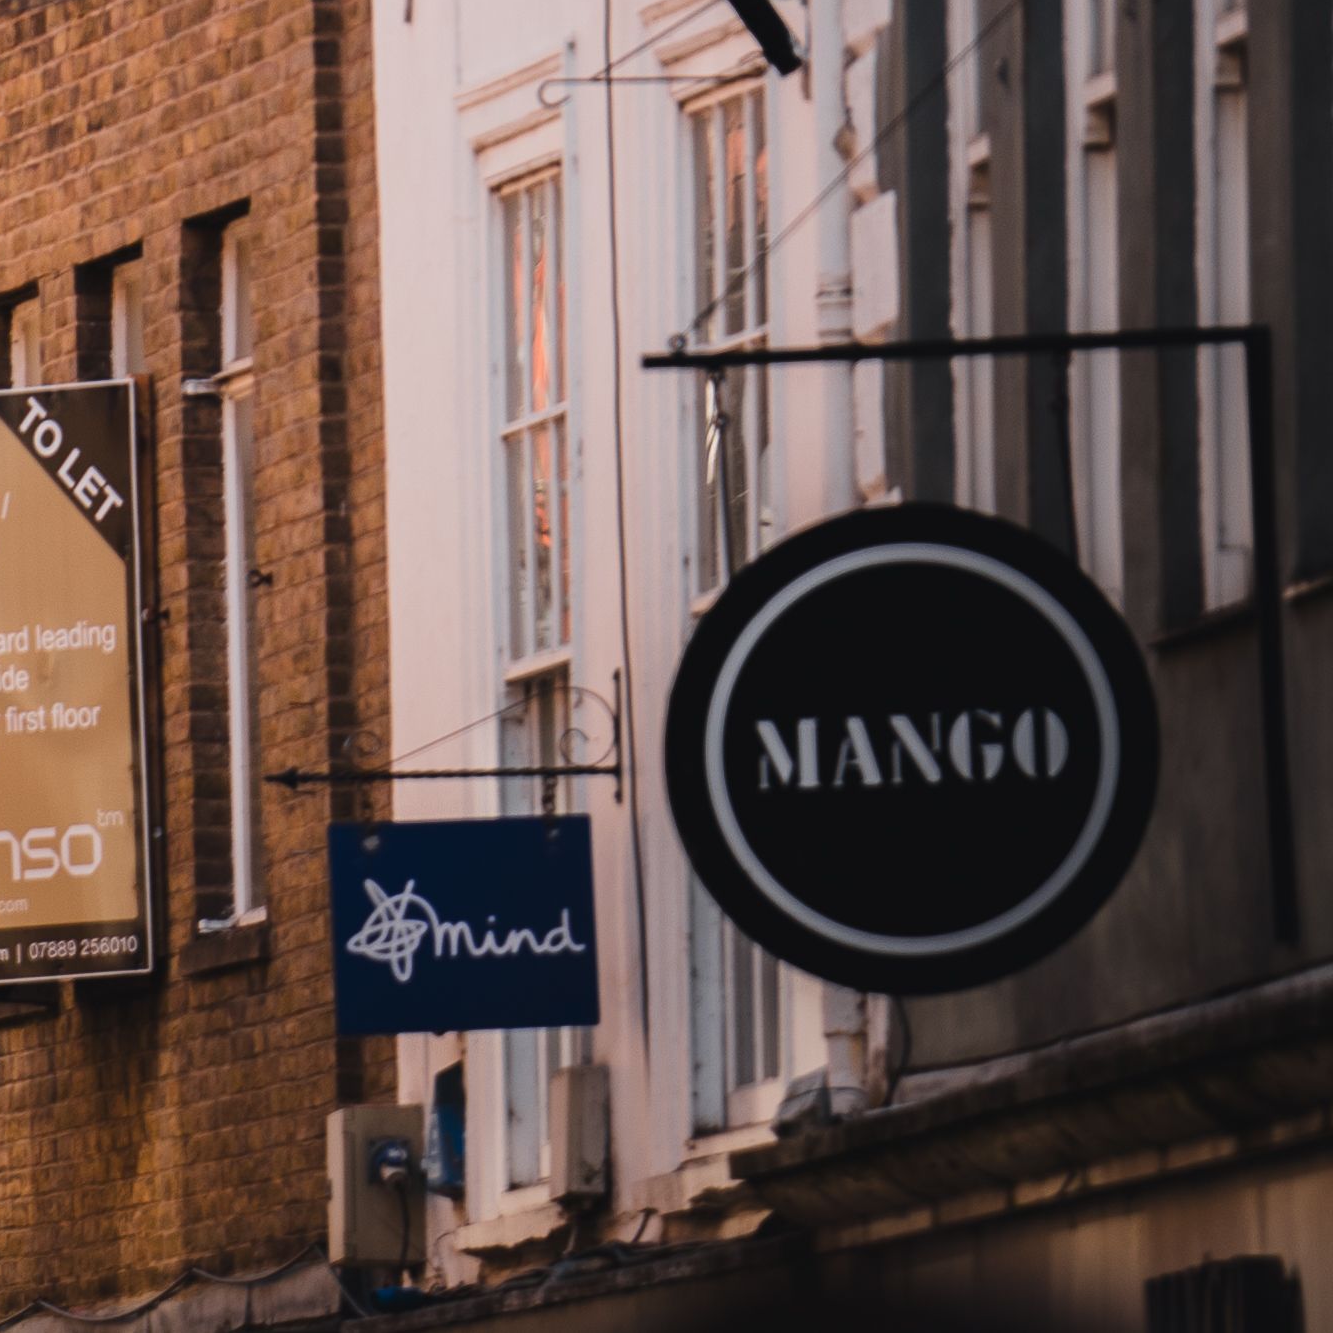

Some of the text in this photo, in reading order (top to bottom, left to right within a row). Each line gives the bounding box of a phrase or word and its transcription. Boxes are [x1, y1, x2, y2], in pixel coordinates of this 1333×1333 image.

[19, 396, 124, 522] TO LET
[36, 621, 116, 653] leading
[5, 704, 46, 733] first
[51, 702, 101, 730] floor
[755, 708, 1069, 789] MANGO
[29, 941, 77, 960] 07889
[80, 935, 138, 956] 256010
[435, 907, 586, 958] mind
